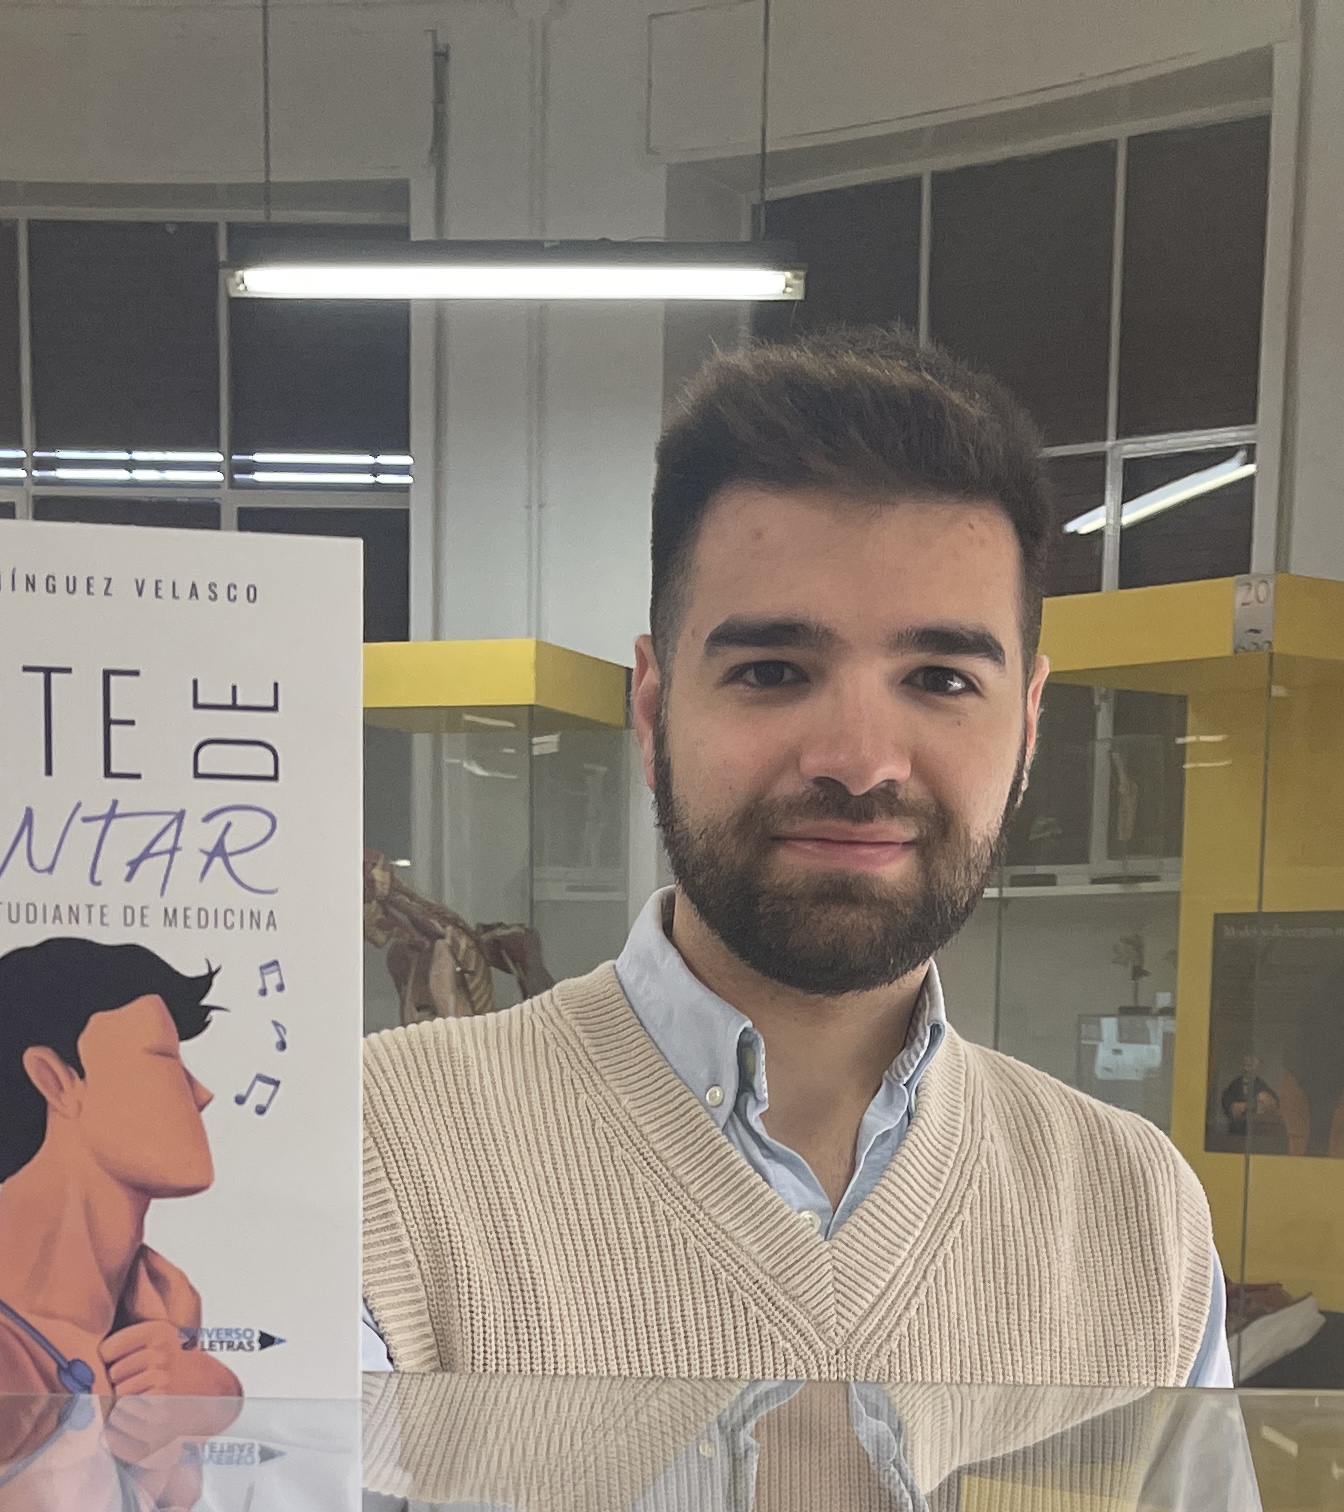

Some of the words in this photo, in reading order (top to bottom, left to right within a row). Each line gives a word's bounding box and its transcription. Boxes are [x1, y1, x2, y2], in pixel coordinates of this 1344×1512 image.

[134, 578, 258, 604] VELASCO
[192, 677, 280, 783] DE
[123, 905, 151, 928] DE
[163, 906, 278, 932] MEDICINA
